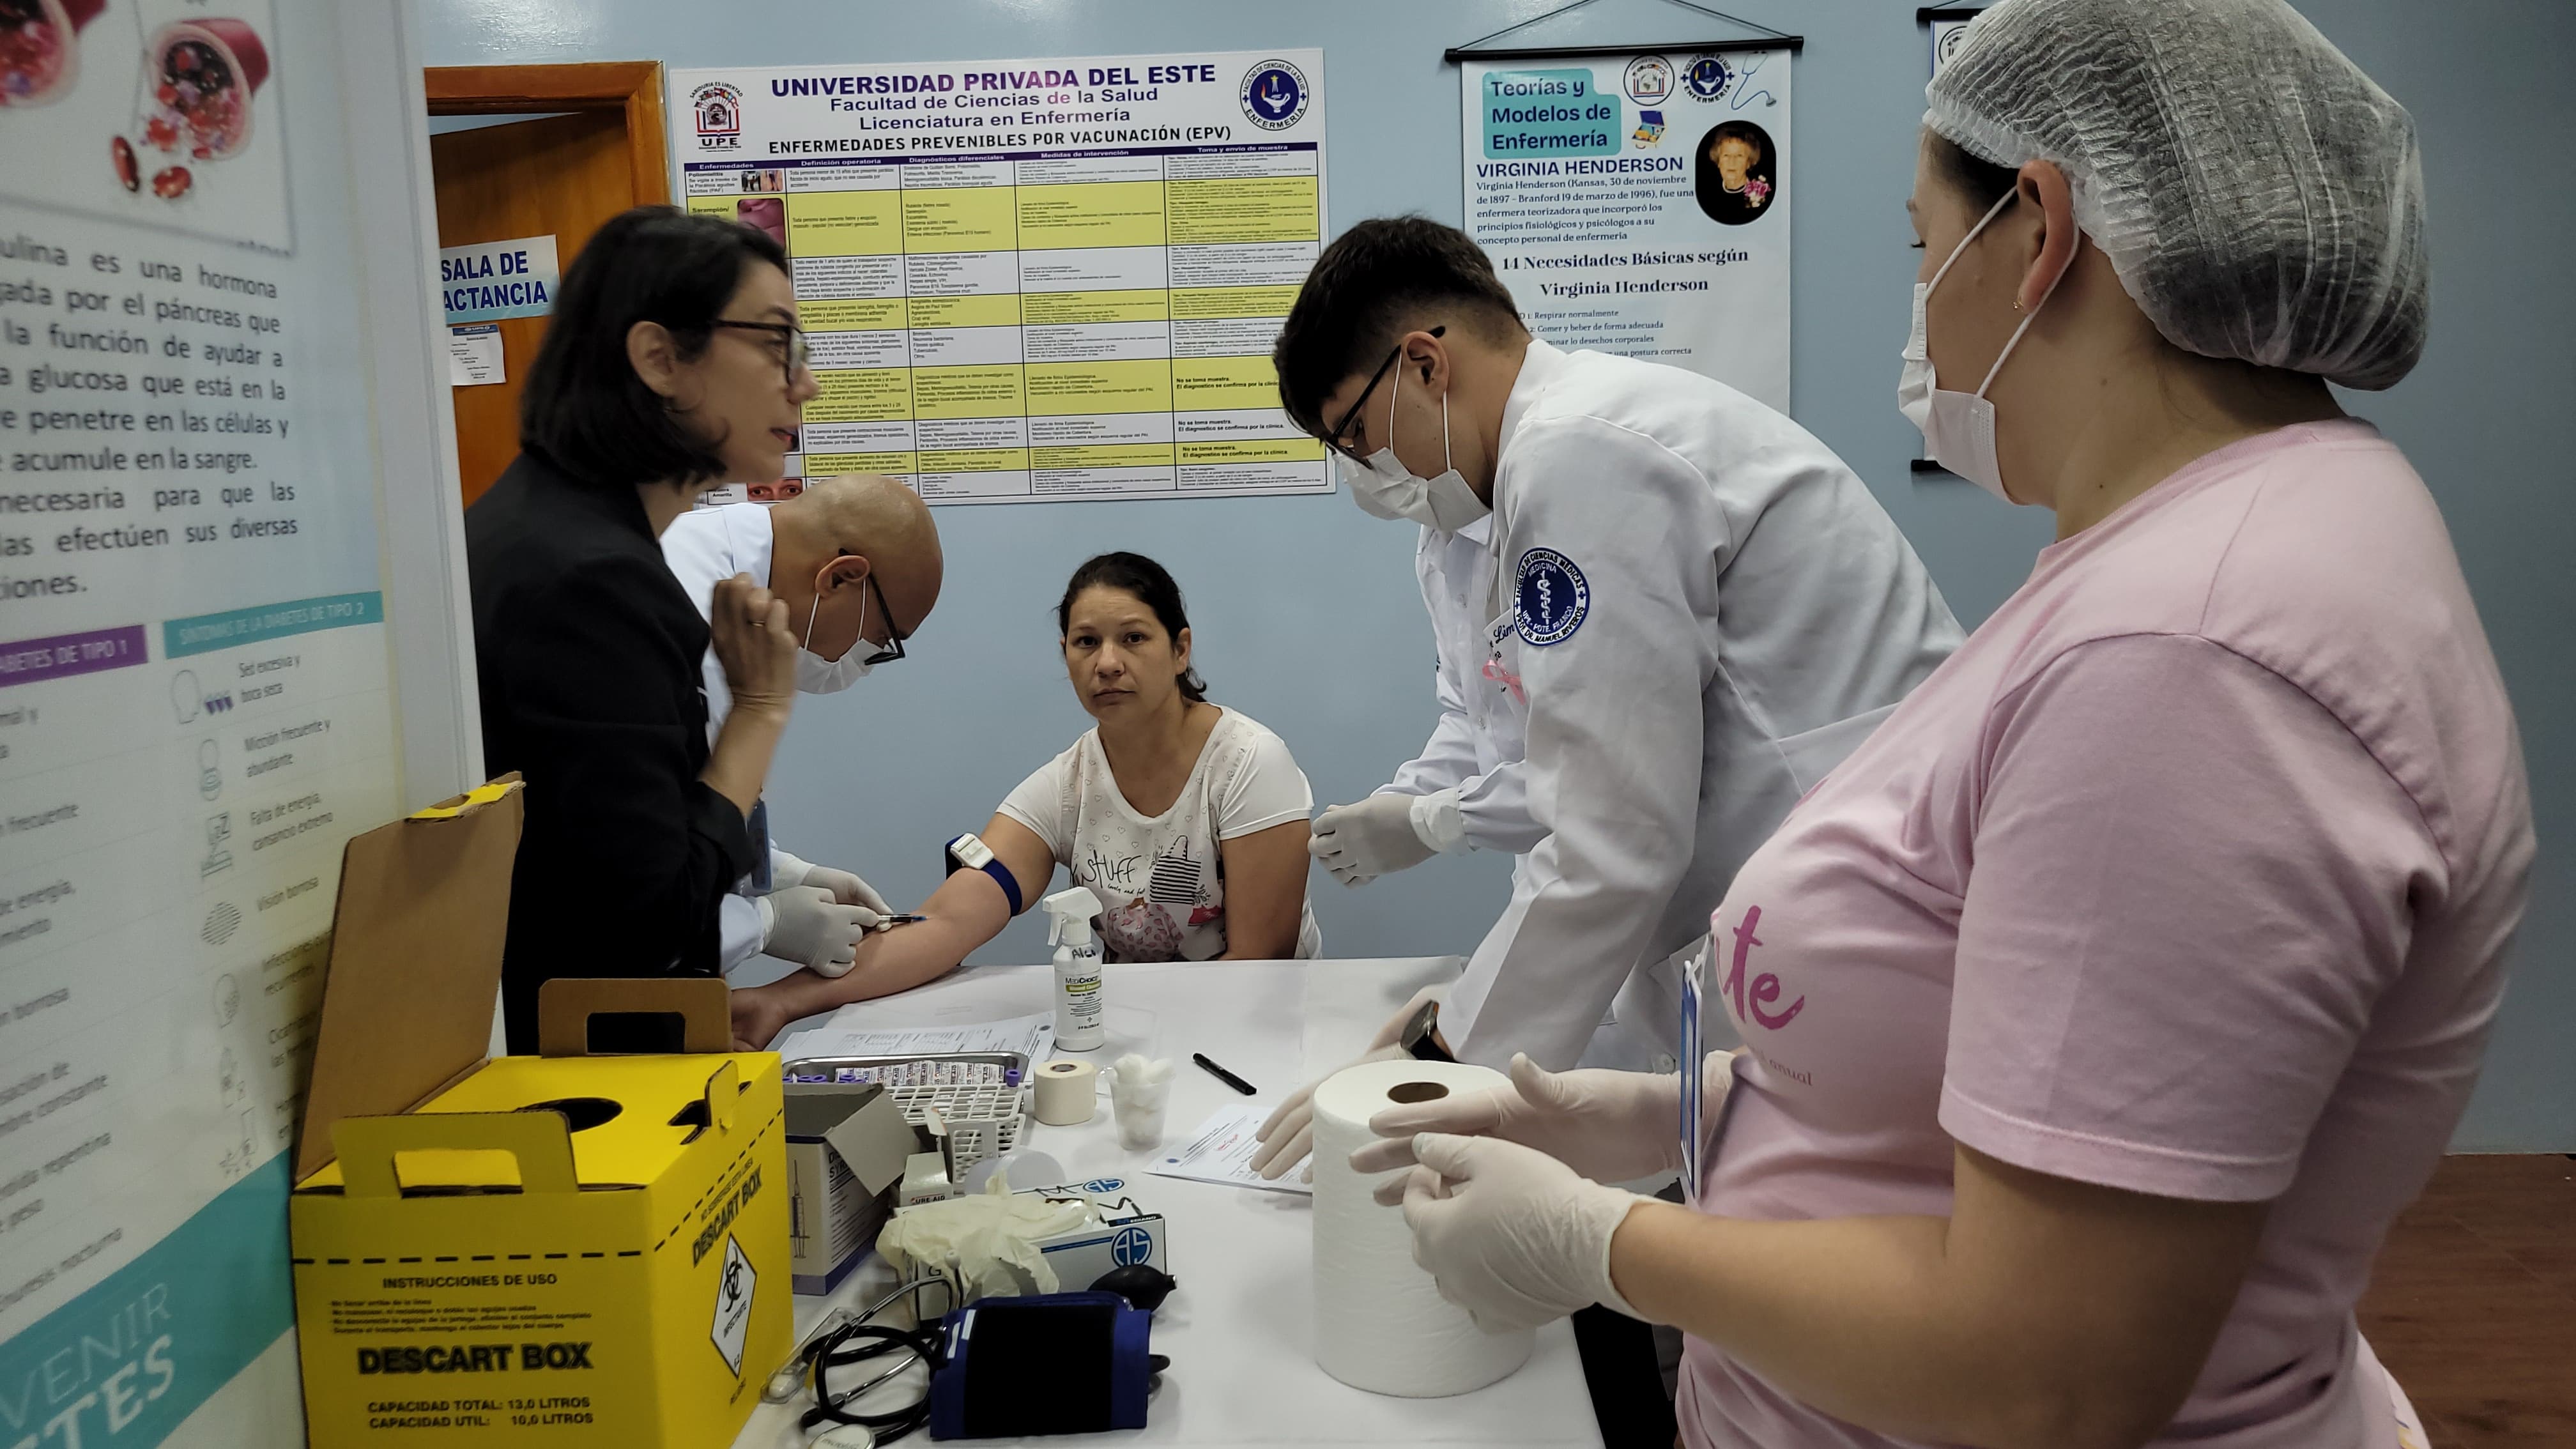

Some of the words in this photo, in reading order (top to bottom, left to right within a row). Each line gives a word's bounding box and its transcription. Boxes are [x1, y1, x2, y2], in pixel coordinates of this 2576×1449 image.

[772, 75, 954, 96] UNIVERSIDAD
[964, 70, 1079, 91] PRIVADA
[1089, 68, 1138, 86] DEL
[1149, 65, 1215, 84] ESTE
[1491, 79, 1567, 96] Teorías
[1573, 81, 1584, 98] y
[831, 96, 916, 111] Facultad
[924, 96, 947, 109] de
[955, 93, 1039, 108] Ciencias
[1048, 91, 1070, 105] de
[1078, 90, 1094, 103] la
[1101, 88, 1157, 102] Salud
[861, 116, 983, 130] Licenciatura
[991, 116, 1013, 126] en
[1022, 109, 1130, 125] Enfermería
[1492, 105, 1579, 123] Modelos
[1586, 103, 1610, 120] de
[769, 138, 905, 153] ENFERMEDADES
[912, 134, 1027, 149] PREVENIBLES
[1034, 132, 1064, 145] POR
[1070, 125, 1179, 143] VACUNACIÓN
[1186, 126, 1230, 141] (EPV)
[1493, 130, 1607, 150] Enfermería
[1477, 162, 1559, 177] VIRGINIA
[1566, 157, 1682, 174] HENDERSON
[1476, 181, 1513, 192] Virginia
[1516, 180, 1565, 189] Henderson
[1568, 179, 1607, 188] (Kansas,
[1610, 177, 1621, 186] 30
[1623, 177, 1634, 185] de
[1637, 176, 1686, 185] noviembre
[1491, 195, 1510, 204] 1897
[1519, 194, 1560, 203] Branford
[1563, 193, 1570, 201] 19
[1573, 192, 1583, 201] de
[1618, 191, 1628, 199] de
[1660, 189, 1675, 197] fue
[1528, 207, 1580, 216] teorizadora
[1583, 208, 1600, 216] que
[1602, 204, 1647, 214] incorporó
[1650, 203, 1662, 211] los
[1478, 222, 1523, 233] principios
[1526, 220, 1576, 230] fisiológicos
[1579, 222, 1584, 230] y
[1586, 218, 1634, 229] psicólogos
[1477, 237, 1520, 247] concepto
[1522, 234, 1561, 245] personal
[441, 256, 494, 281] SALA
[500, 251, 528, 275] DE
[1503, 257, 1519, 270] 14
[1524, 253, 1627, 269] Necesidades
[1633, 251, 1694, 266] Básicas
[1697, 249, 1749, 266] según
[444, 281, 548, 312] ACTANCIA
[1540, 282, 1609, 298] Virginia
[1616, 280, 1707, 293] Henderson
[1537, 325, 1563, 333] Comer
[1570, 323, 1591, 331] beber
[1593, 322, 1602, 330] de
[1604, 321, 1627, 330] forma
[1629, 320, 1664, 329] adecuada
[4, 319, 31, 346] la
[48, 323, 149, 354] función
[162, 335, 191, 359] de
[204, 343, 262, 365] ayudar
[1579, 335, 1613, 345] desechos
[1614, 335, 1655, 345] corporales
[1630, 349, 1659, 358] postura
[1660, 347, 1692, 355] correcta
[29, 365, 128, 393] glucosa
[141, 375, 185, 397] que
[194, 376, 233, 397] está
[241, 383, 263, 399] en
[271, 379, 286, 401] la
[29, 410, 135, 433] penetre
[144, 414, 174, 432] en
[181, 410, 209, 433] las
[215, 412, 273, 434] células
[12, 447, 128, 471] acumule
[134, 452, 165, 471] en
[169, 447, 190, 470] la
[194, 452, 257, 474] sangre.
[153, 489, 201, 510] para
[220, 487, 254, 508] que
[270, 480, 295, 502] las
[1529, 551, 1558, 563] CIENCIAS
[1528, 562, 1557, 577] MEDICINA
[327, 602, 352, 617] TIPO
[356, 602, 364, 615] 2
[1552, 605, 1574, 631] FRANCO
[1533, 631, 1565, 643] MANUEL
[1561, 605, 1585, 638] RIVEROS
[1714, 905, 1805, 1031] te
[693, 1191, 741, 1269] DESCART
[742, 1163, 762, 1209] BOX
[383, 1275, 499, 1288] INSTRUCCIONES
[504, 1275, 523, 1285] DE
[527, 1273, 557, 1285] USO
[358, 1346, 513, 1374] DESCART
[521, 1342, 594, 1370] BOX
[368, 1401, 450, 1413] CAPACIDAD
[454, 1400, 502, 1411] TOTAL:
[508, 1399, 535, 1411] 13,0
[539, 1397, 590, 1409] LITROS
[369, 1416, 451, 1429] CAPACIDAD
[455, 1416, 489, 1427] UTIL:
[511, 1414, 539, 1426] 10,0
[542, 1413, 593, 1424] LITROS
